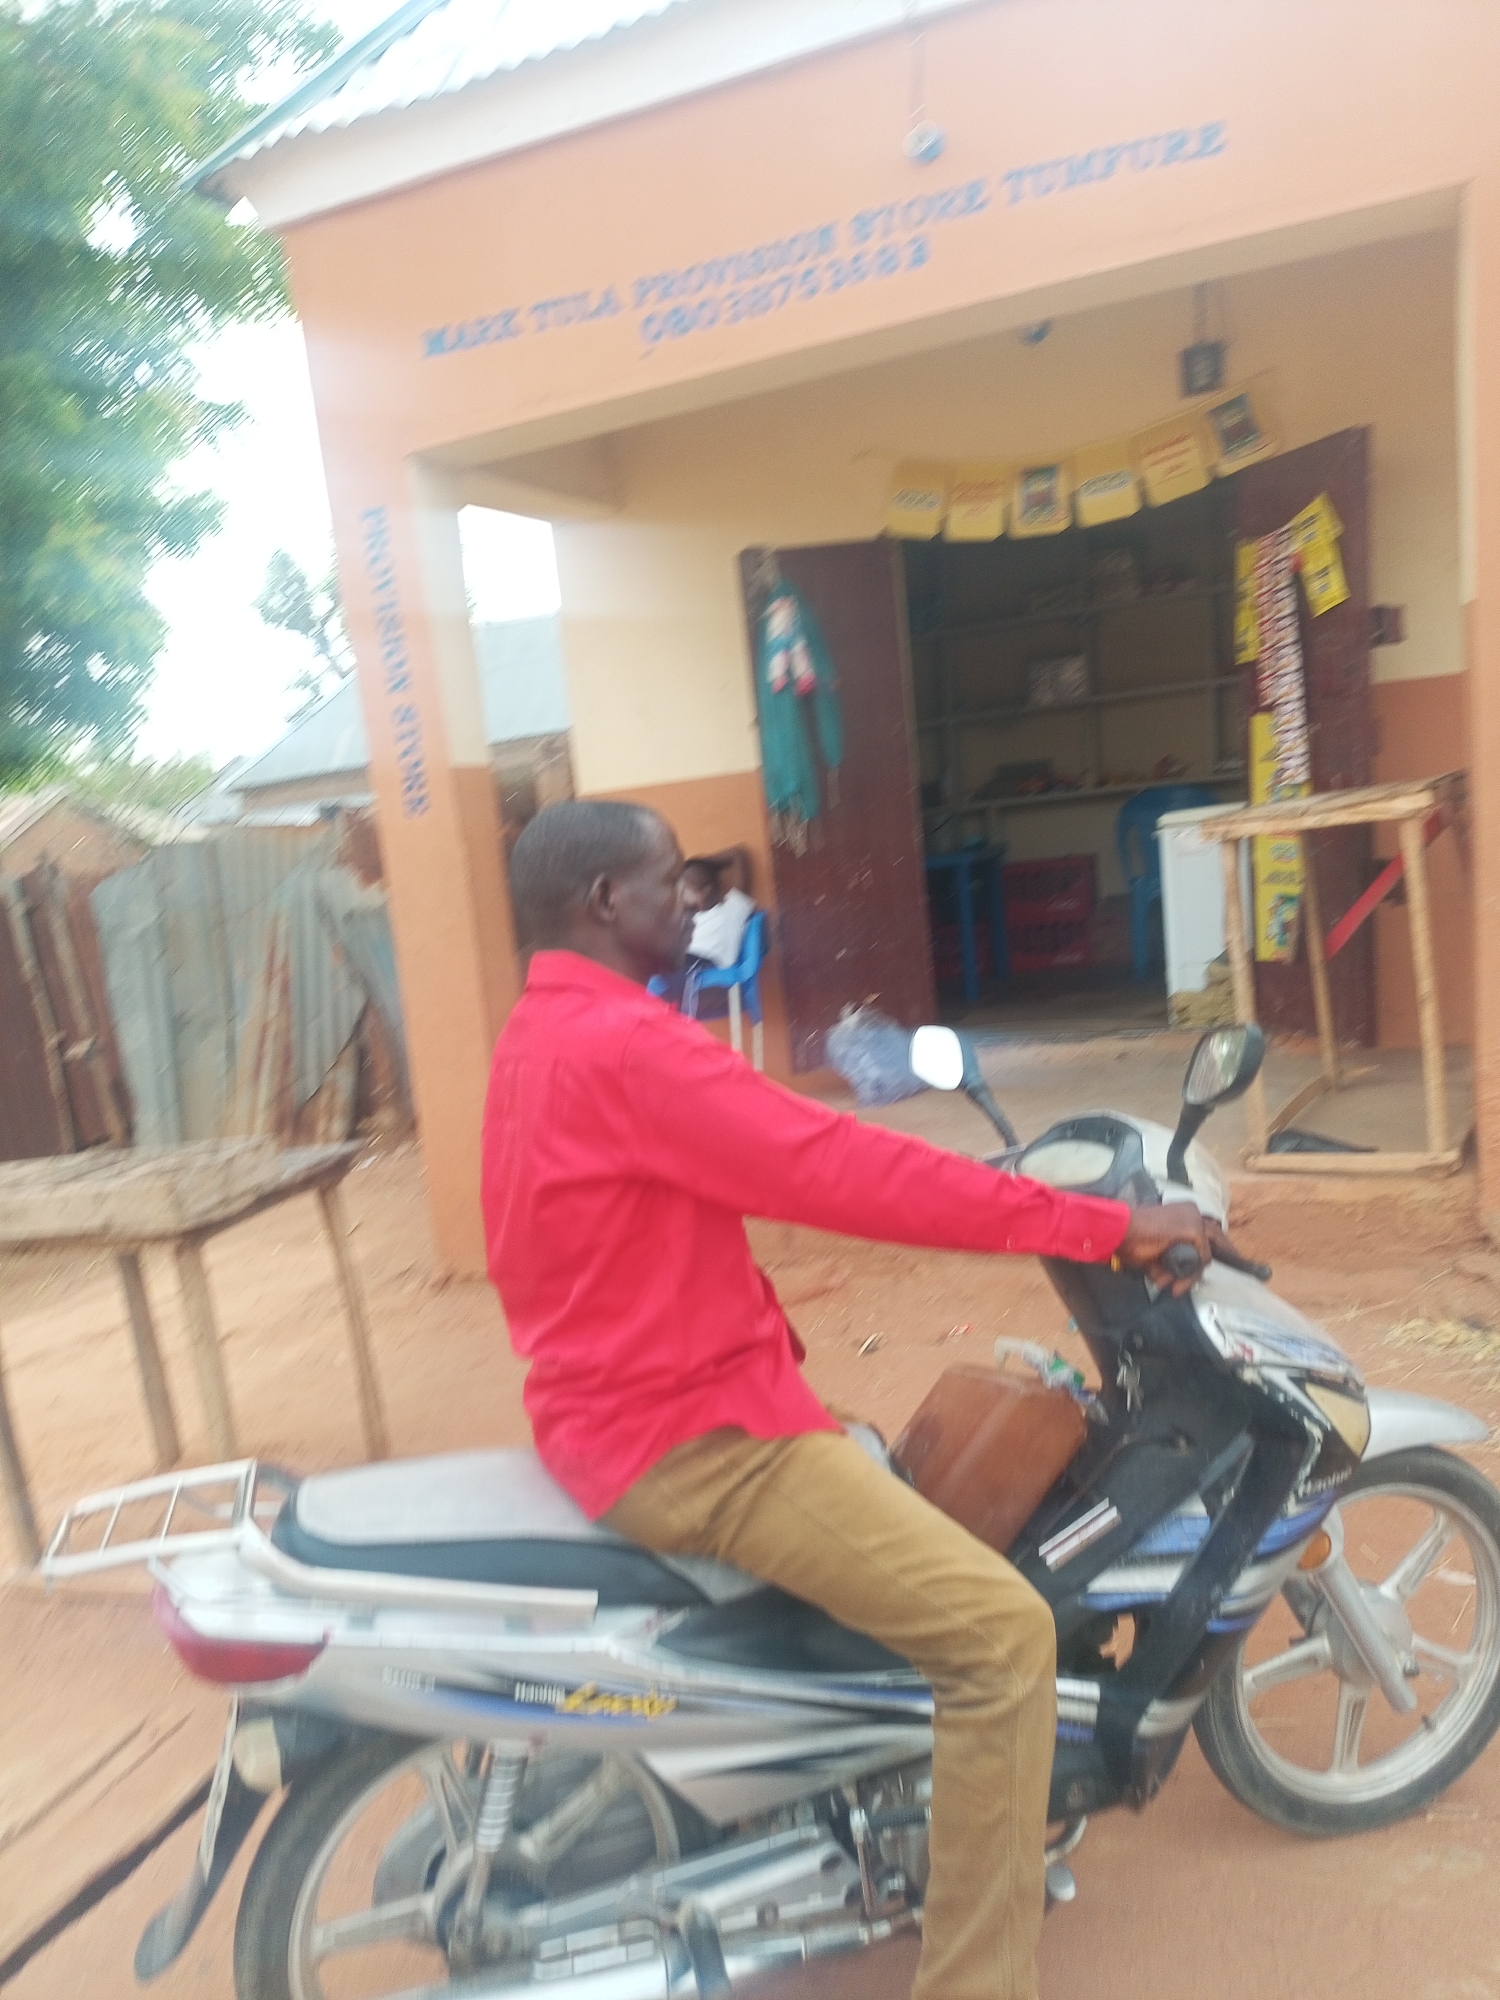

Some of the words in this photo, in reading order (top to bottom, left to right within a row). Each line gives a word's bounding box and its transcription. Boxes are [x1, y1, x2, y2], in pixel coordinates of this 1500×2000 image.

[422, 306, 523, 358] MARK
[529, 285, 625, 335] TULA
[631, 222, 837, 307] PROVISION
[850, 177, 990, 243] STORE
[1000, 120, 1228, 206] TUMFURE
[360, 504, 413, 695] PROVISION
[390, 702, 431, 820] STORE
